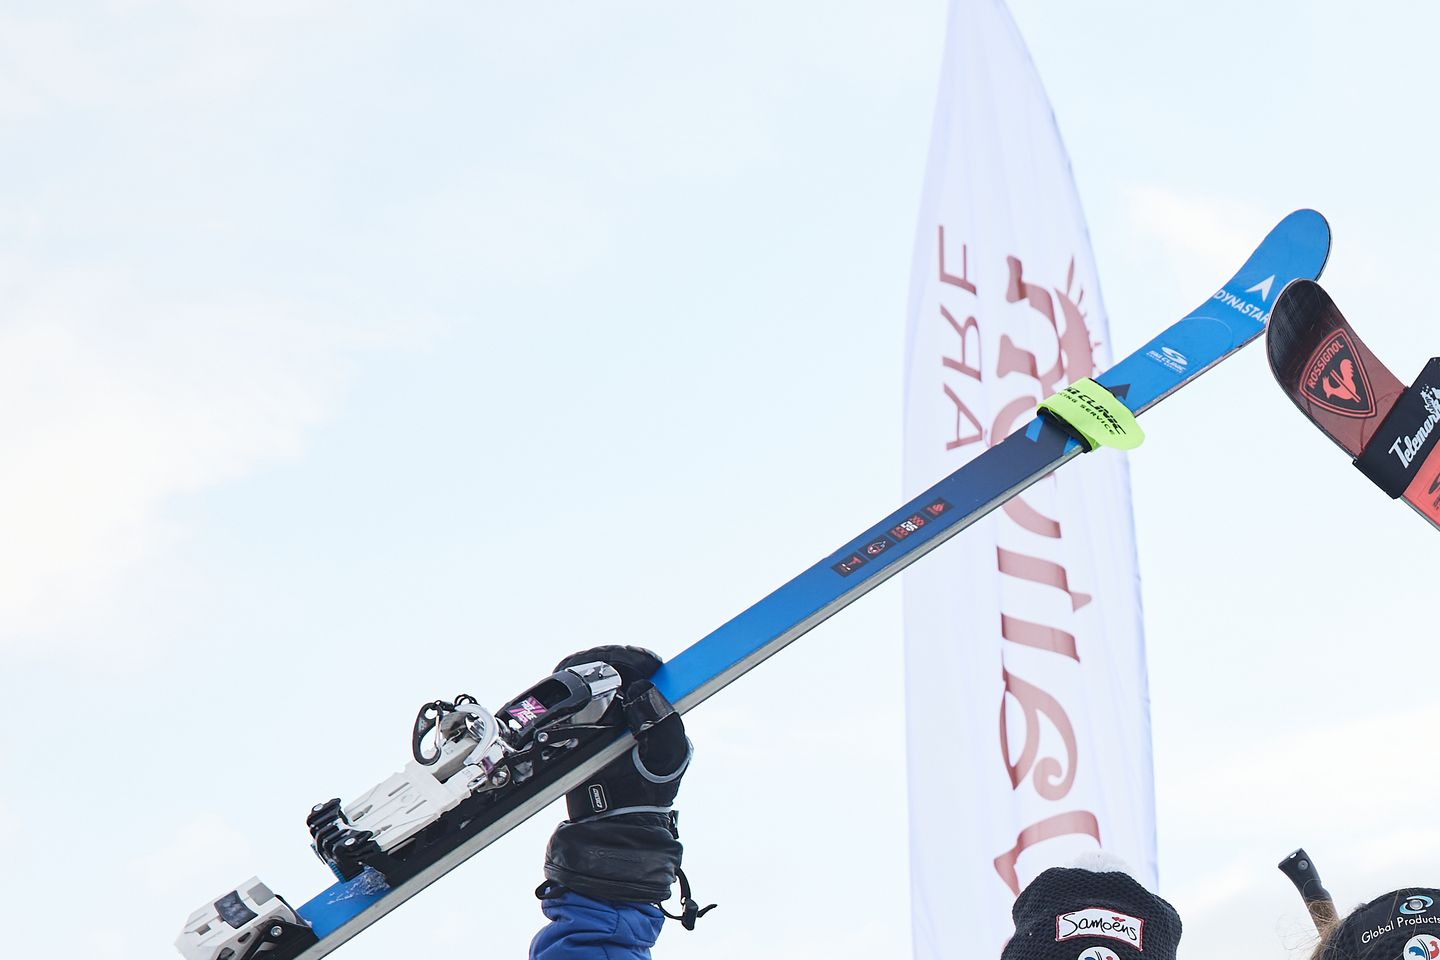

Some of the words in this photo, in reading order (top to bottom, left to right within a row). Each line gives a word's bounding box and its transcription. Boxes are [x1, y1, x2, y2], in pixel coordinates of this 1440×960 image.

[1213, 288, 1271, 325] DYNASTAR
[1307, 340, 1344, 390] ROSSIGNOL
[1078, 394, 1127, 435] CLINIC
[1080, 403, 1116, 436] SERVICE
[1361, 920, 1395, 944] Global
